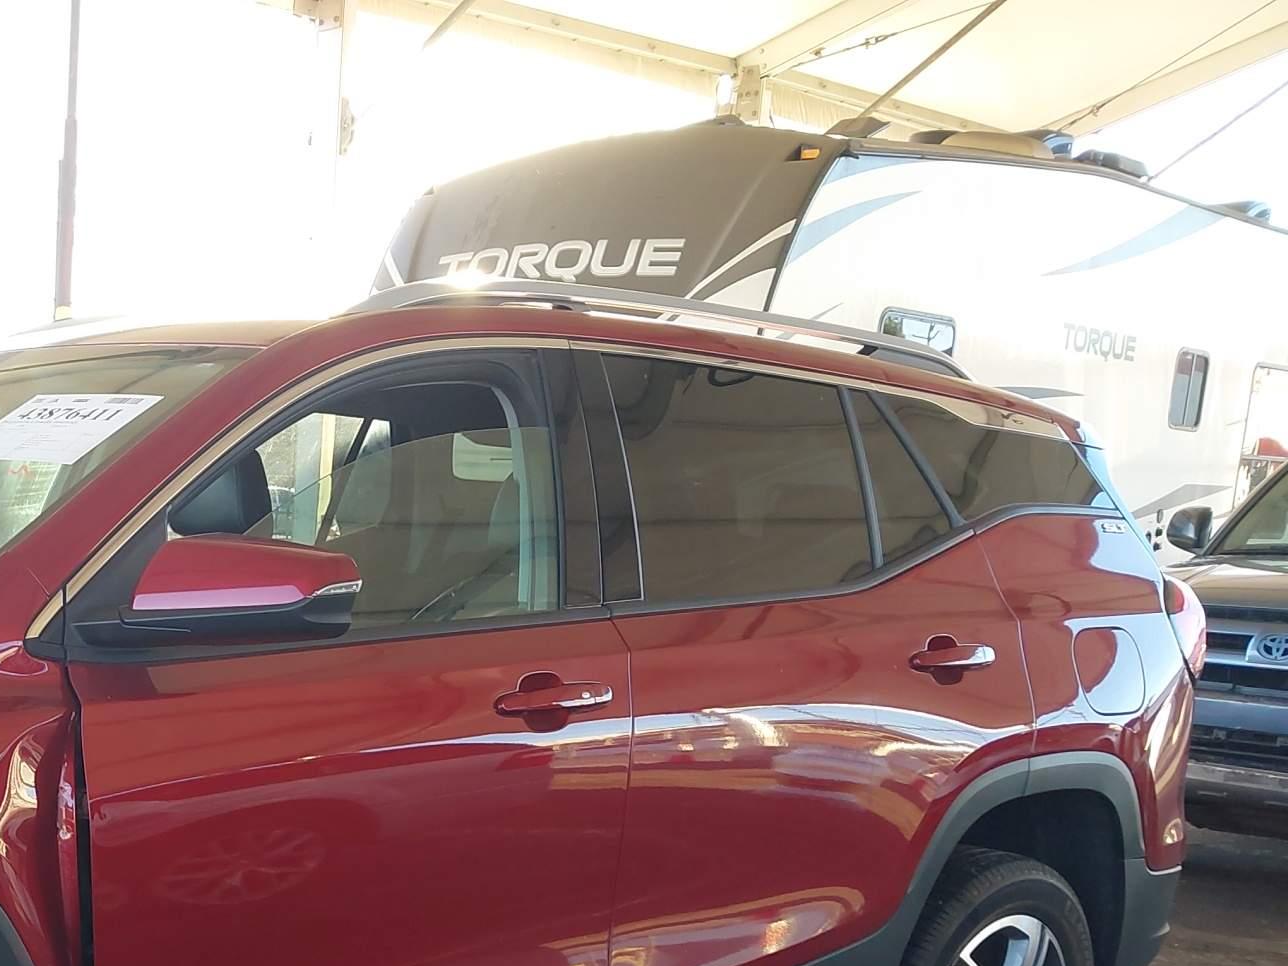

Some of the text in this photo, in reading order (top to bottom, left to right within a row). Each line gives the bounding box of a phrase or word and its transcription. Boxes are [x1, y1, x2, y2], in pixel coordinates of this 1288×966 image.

[439, 238, 686, 282] TORQUE
[1063, 322, 1137, 362] TORQUE
[19, 408, 123, 421] 43876411
